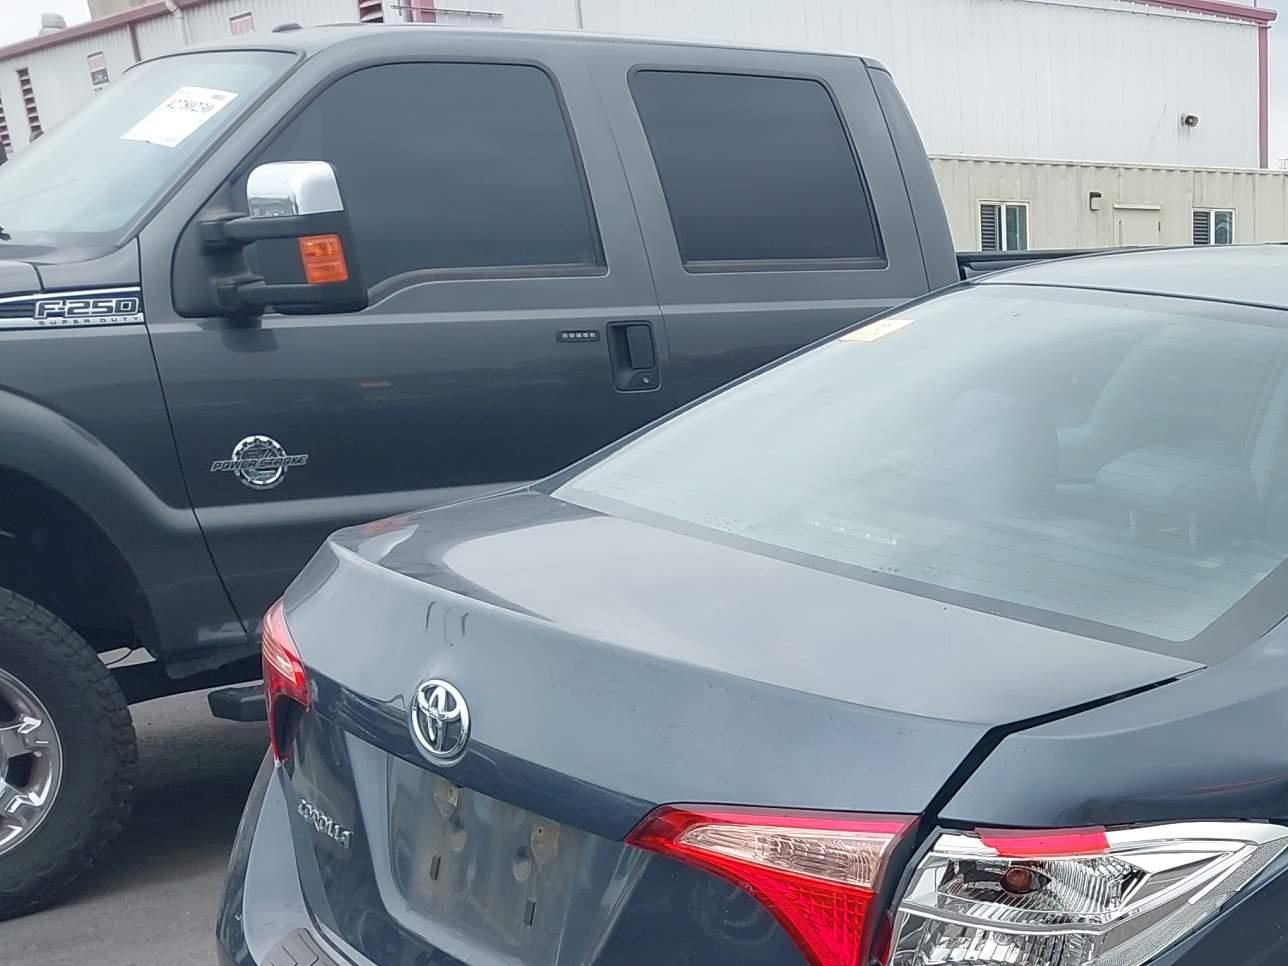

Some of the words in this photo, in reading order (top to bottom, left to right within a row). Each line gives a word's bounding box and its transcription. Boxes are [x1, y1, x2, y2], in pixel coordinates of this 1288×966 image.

[38, 318, 91, 326] SUPER
[210, 459, 260, 472] POWER
[255, 454, 309, 469] STROKE
[297, 798, 354, 849] COROLLA
